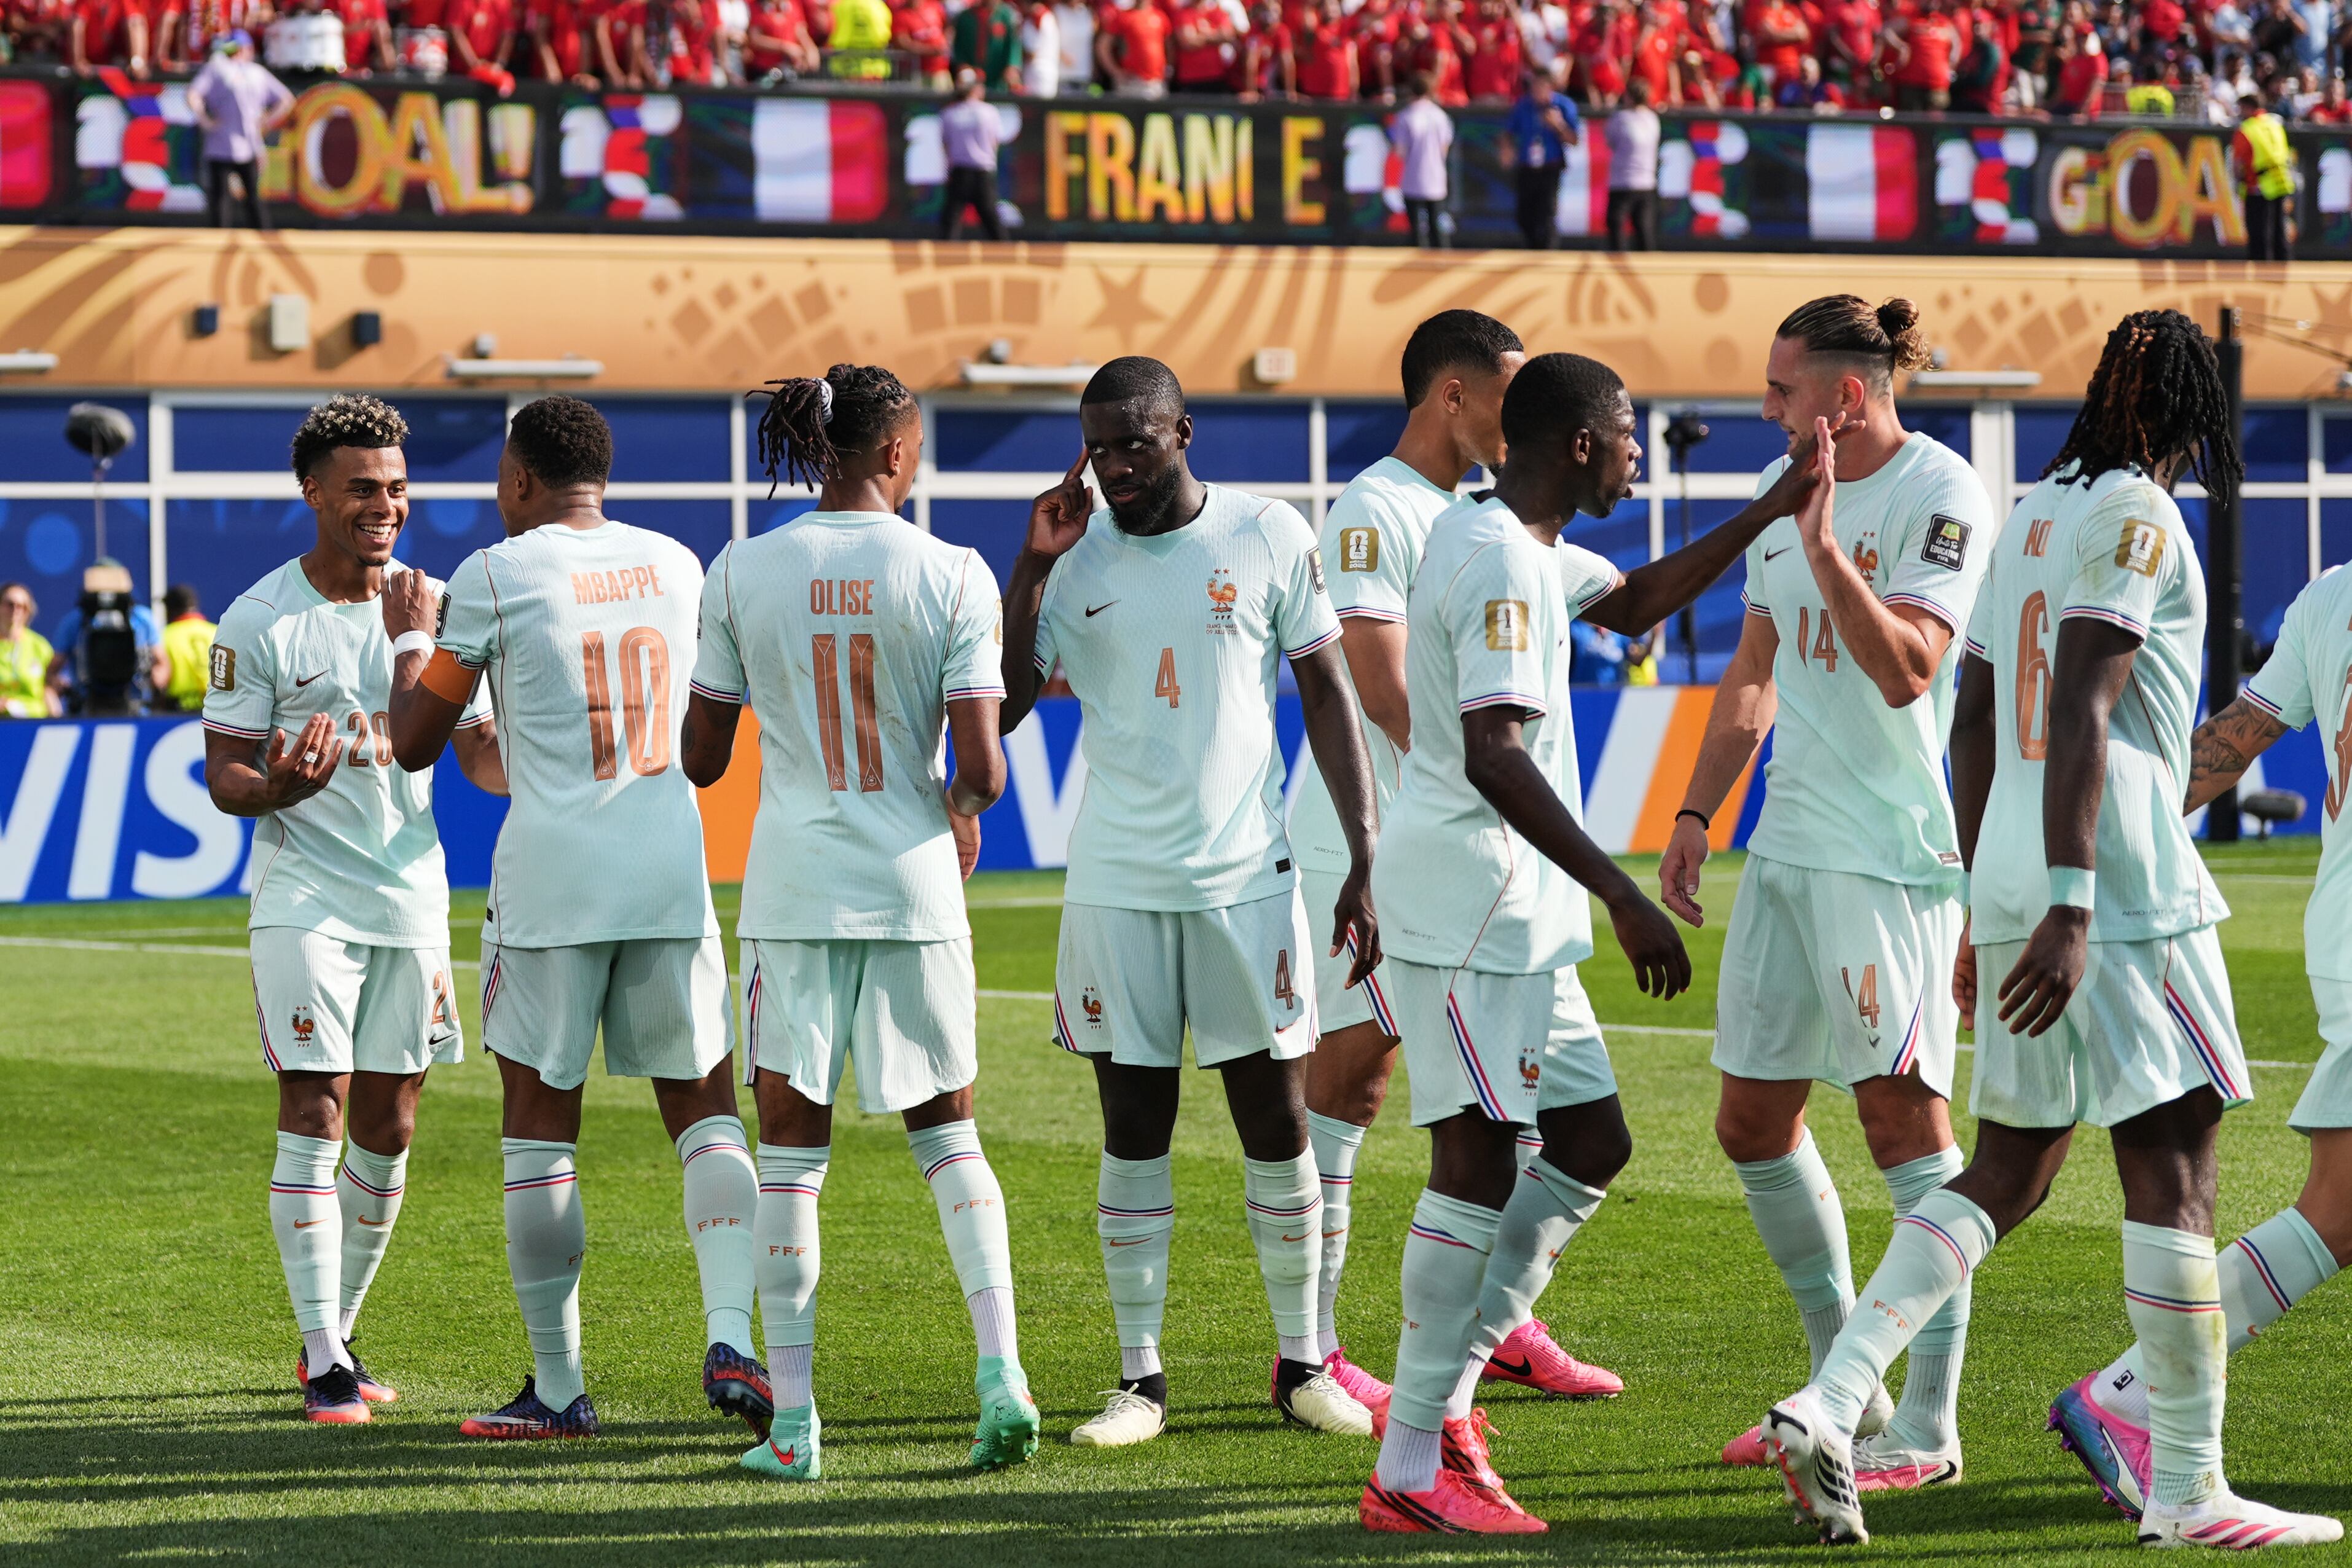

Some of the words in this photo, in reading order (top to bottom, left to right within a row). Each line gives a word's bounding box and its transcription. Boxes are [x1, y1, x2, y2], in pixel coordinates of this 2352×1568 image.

[1930, 544, 1959, 561] EDUCATION
[570, 565, 664, 605] MBAPPE
[810, 579, 875, 616] OLISE
[1798, 606, 1838, 673] 14
[581, 627, 670, 782] 10
[1154, 647, 1181, 708] 4
[2015, 590, 2054, 761] 6
[347, 711, 393, 767] 20
[812, 633, 885, 793] 11
[1275, 949, 1295, 1010] 4
[1841, 963, 1880, 1029] 14
[697, 1217, 741, 1233] FFF
[954, 1199, 996, 1213] FFF
[769, 1245, 807, 1256] FFF
